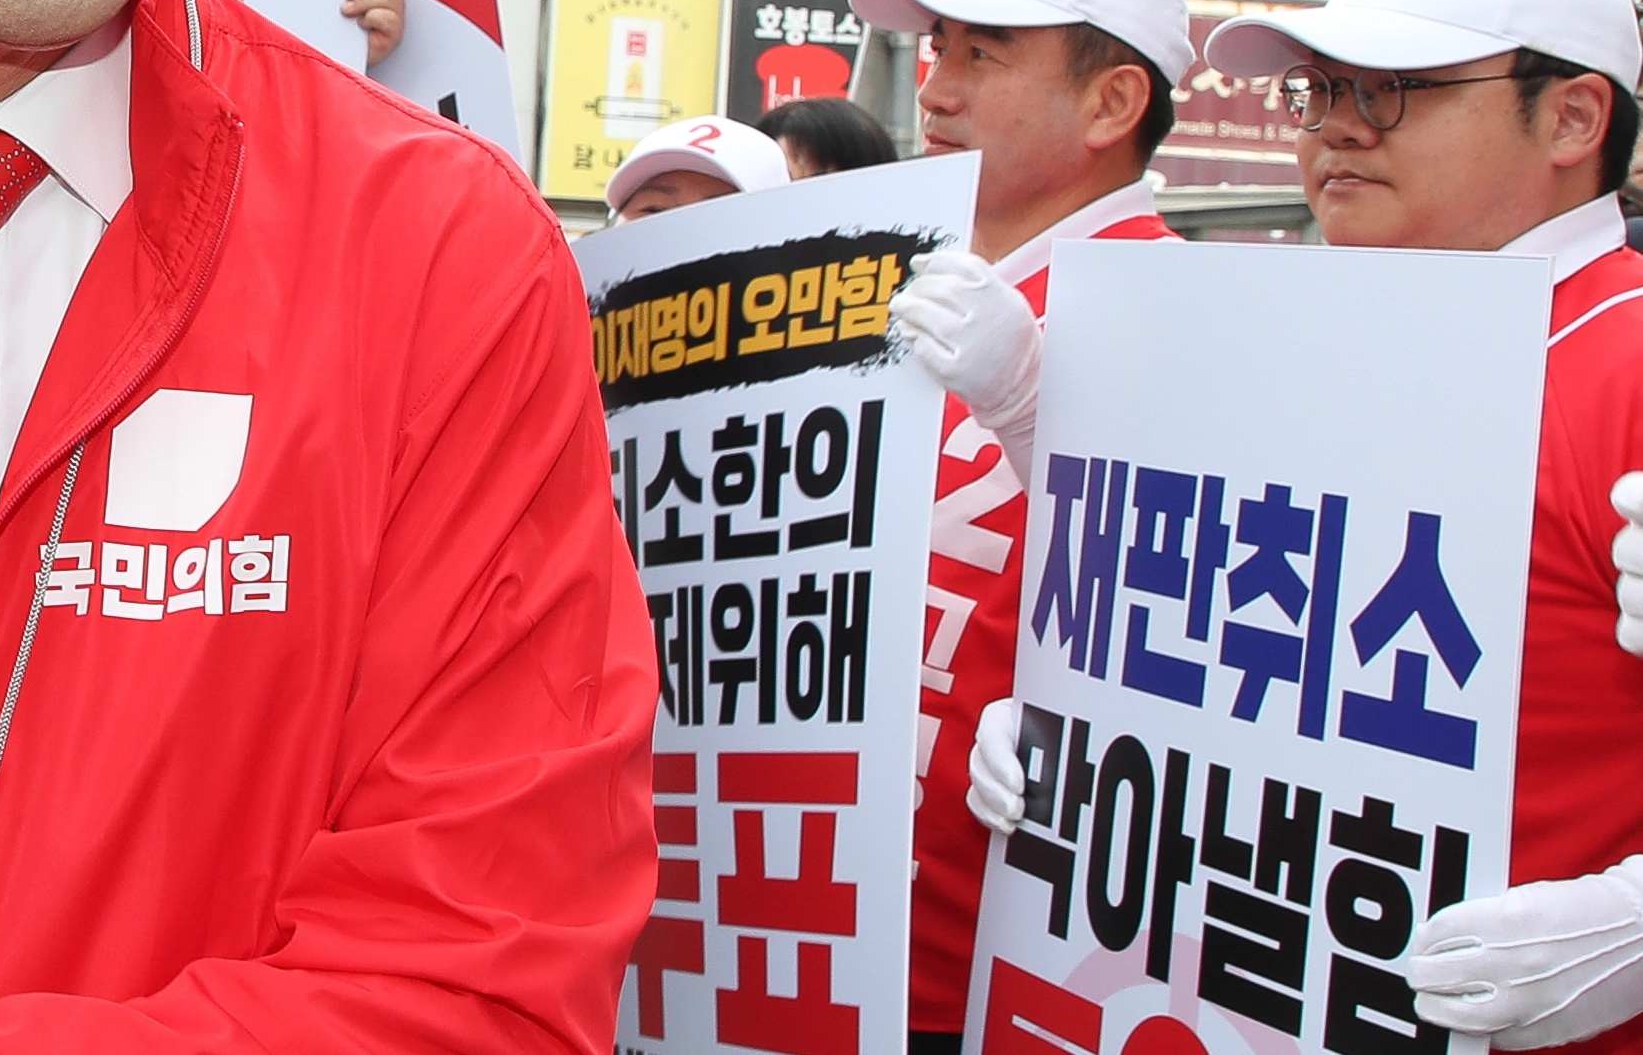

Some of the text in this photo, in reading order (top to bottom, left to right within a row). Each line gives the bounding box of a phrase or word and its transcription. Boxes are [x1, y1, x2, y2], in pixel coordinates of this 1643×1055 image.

[686, 123, 722, 155] 2
[737, 253, 903, 356] 오만함
[930, 415, 1023, 575] 2
[35, 534, 291, 622] 국민의힘
[1030, 453, 1484, 771] 재판취소
[1004, 703, 1471, 1055] 막아낼힘
